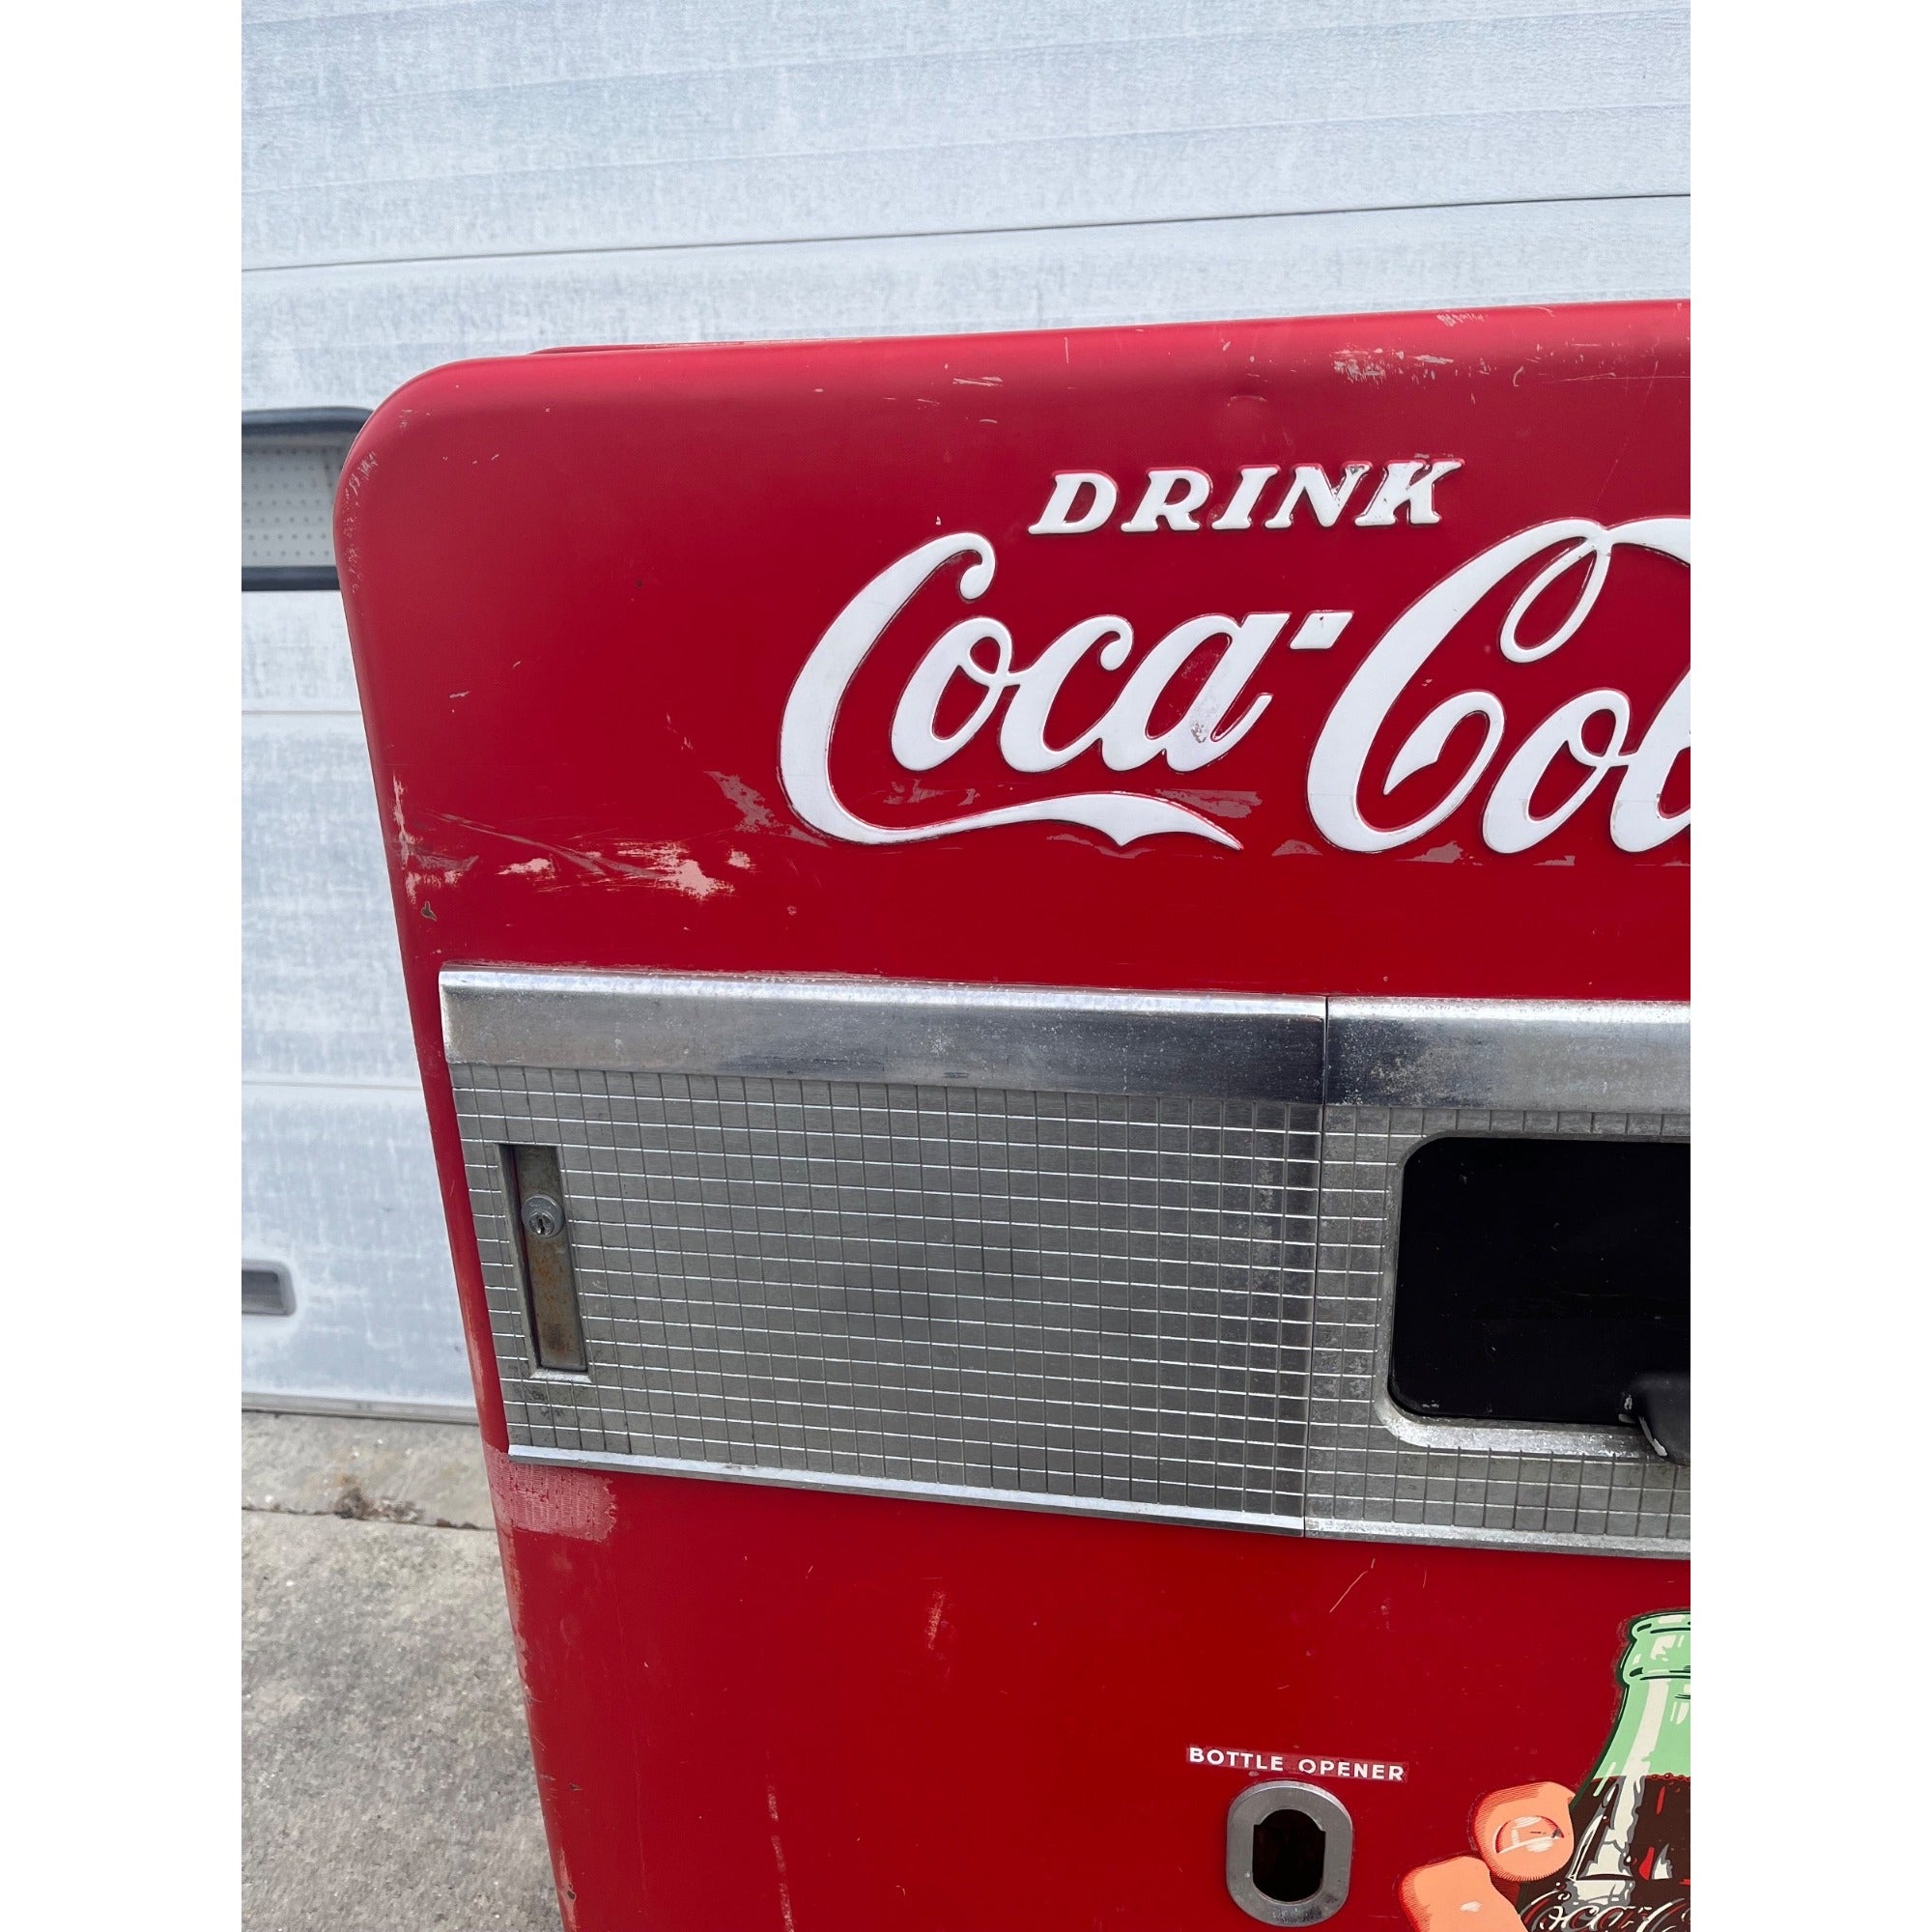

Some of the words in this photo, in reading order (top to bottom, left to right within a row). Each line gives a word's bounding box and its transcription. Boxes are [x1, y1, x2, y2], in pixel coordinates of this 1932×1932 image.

[1028, 459, 1464, 535] DRINK
[1188, 1747, 1284, 1772] BOTTLE
[1297, 1758, 1405, 1781] OPENER
